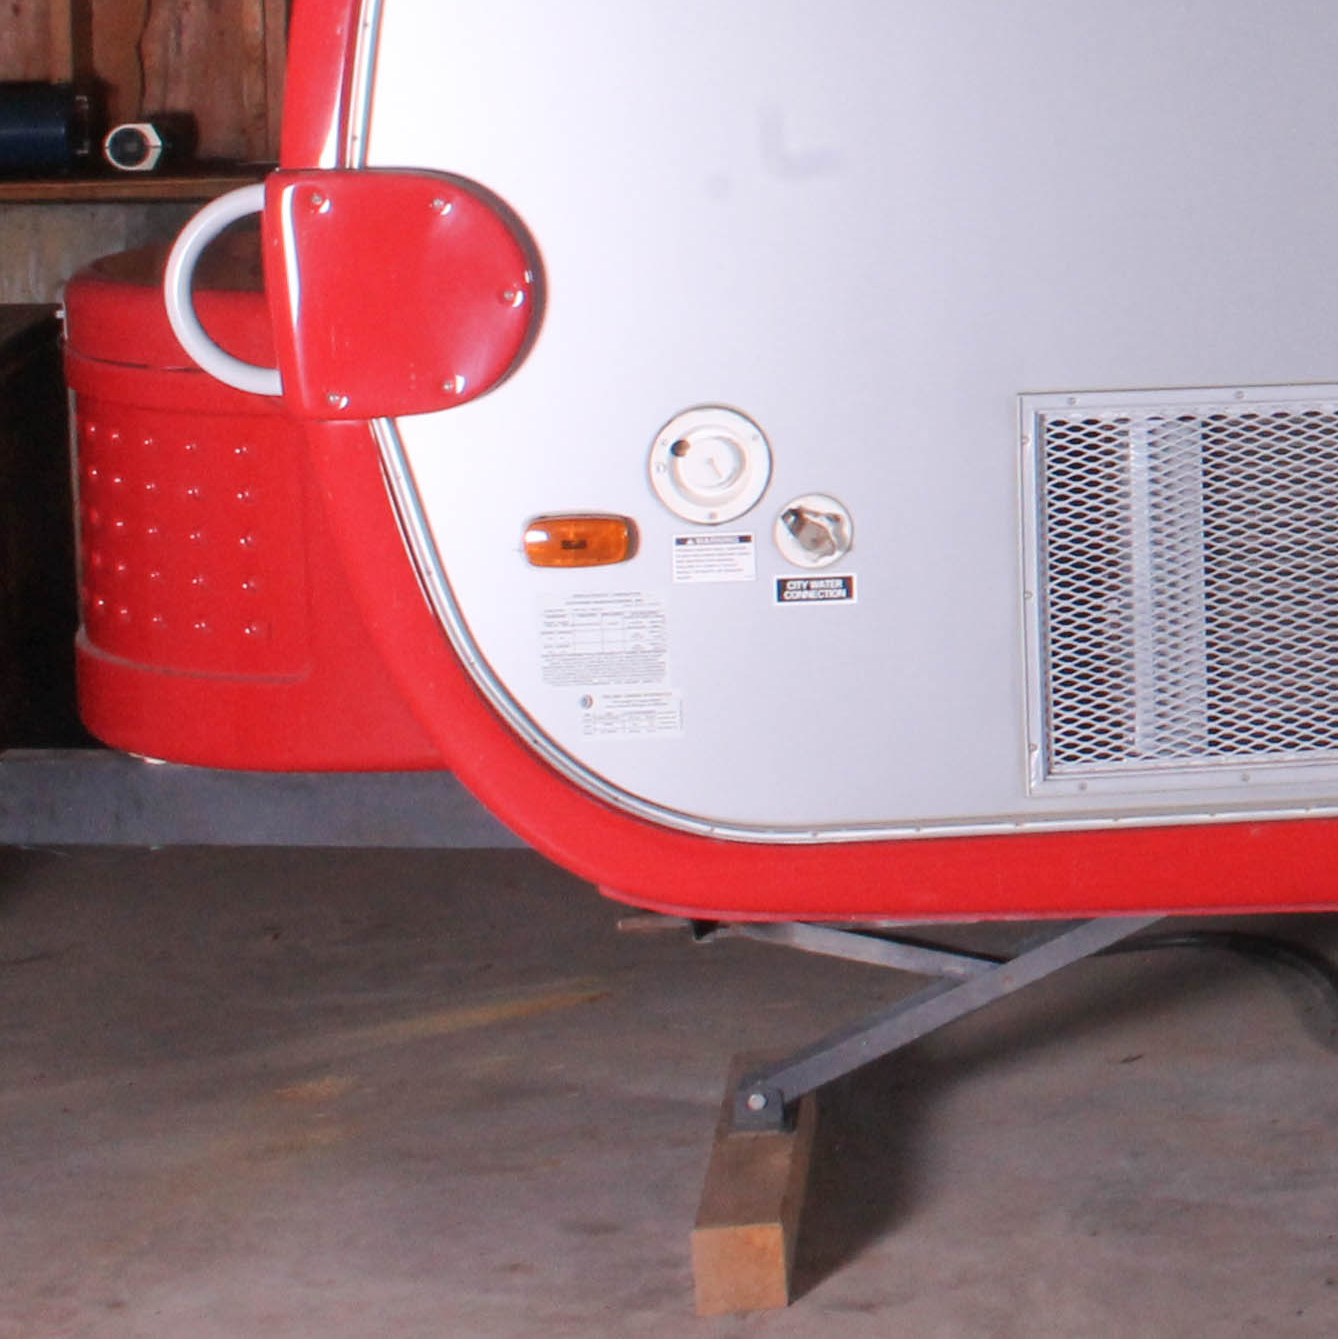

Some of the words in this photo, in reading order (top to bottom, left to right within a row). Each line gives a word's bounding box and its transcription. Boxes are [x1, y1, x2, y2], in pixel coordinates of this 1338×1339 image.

[786, 580, 808, 591] CITY
[809, 579, 843, 589] WATER
[783, 588, 847, 600] CONNECTION
